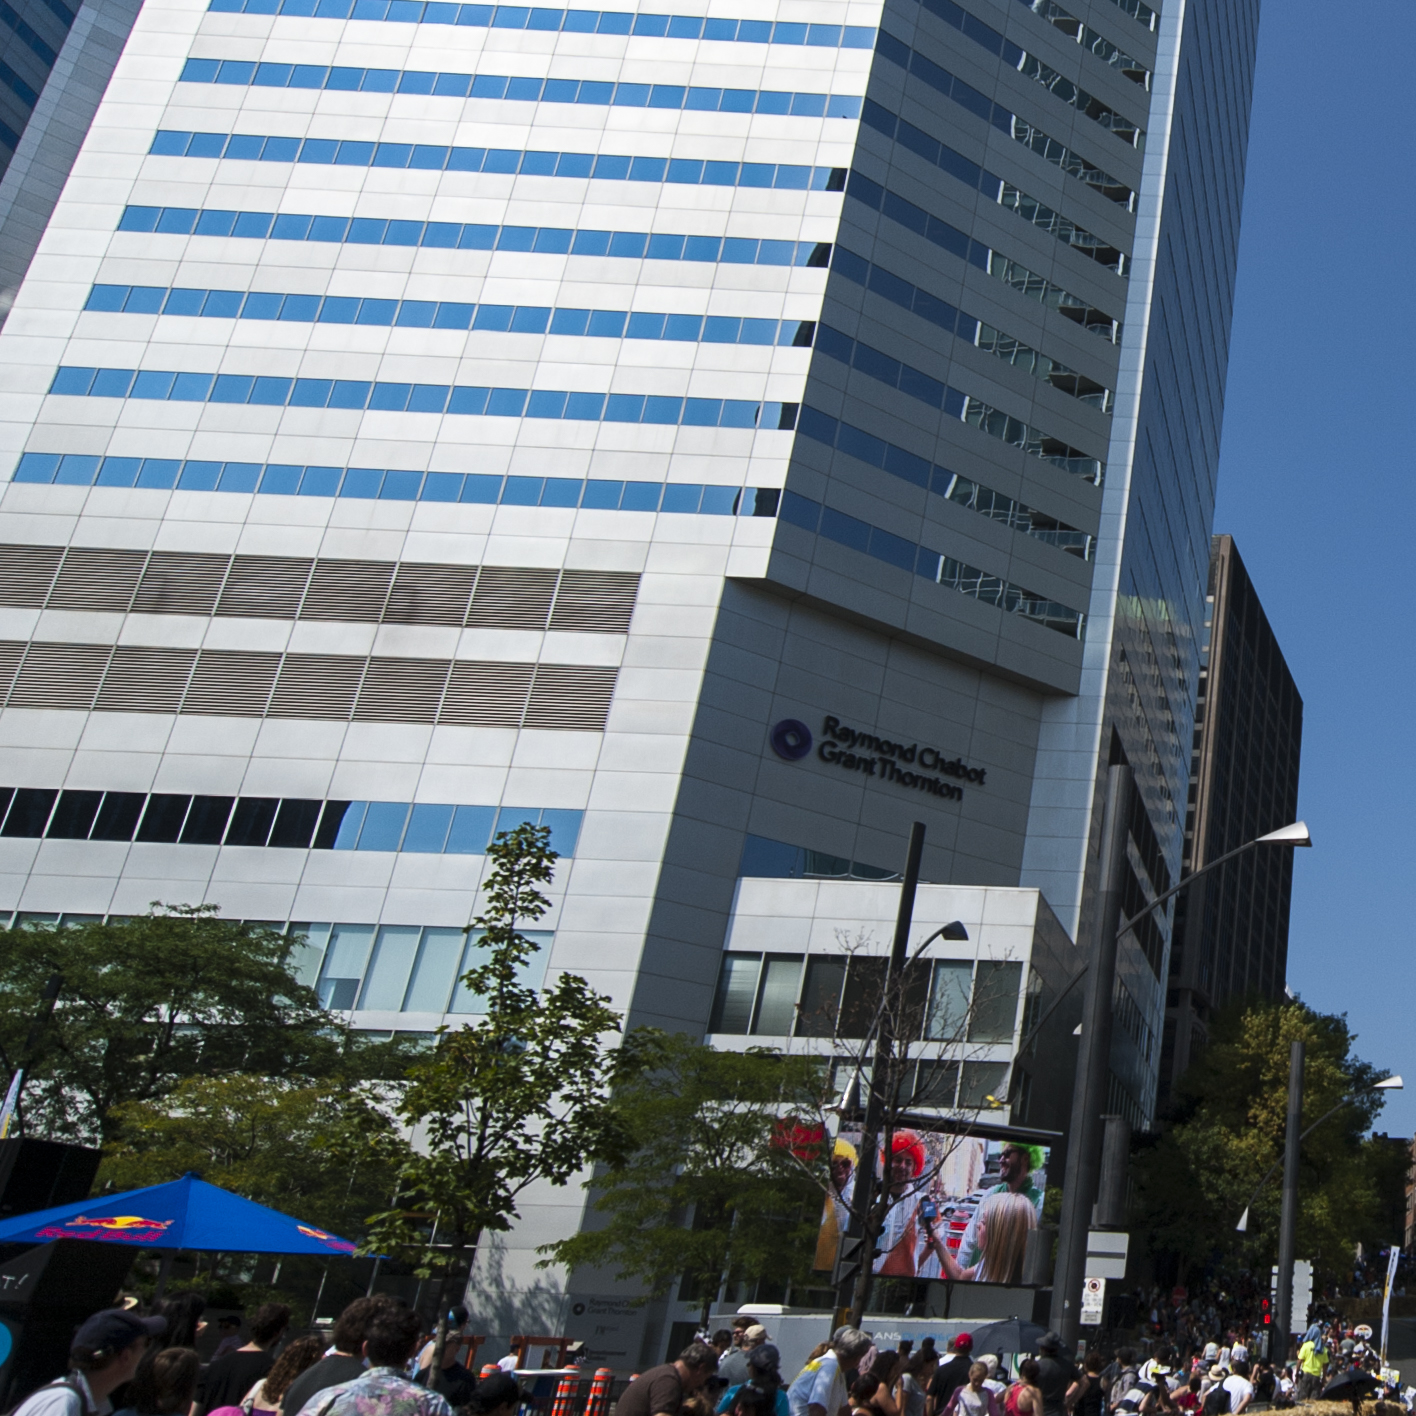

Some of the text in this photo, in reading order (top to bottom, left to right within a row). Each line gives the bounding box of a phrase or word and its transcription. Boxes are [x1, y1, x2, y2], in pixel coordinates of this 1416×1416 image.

[818, 740, 964, 801] Grant Thornton
[822, 715, 987, 785] Raymond Chabot
